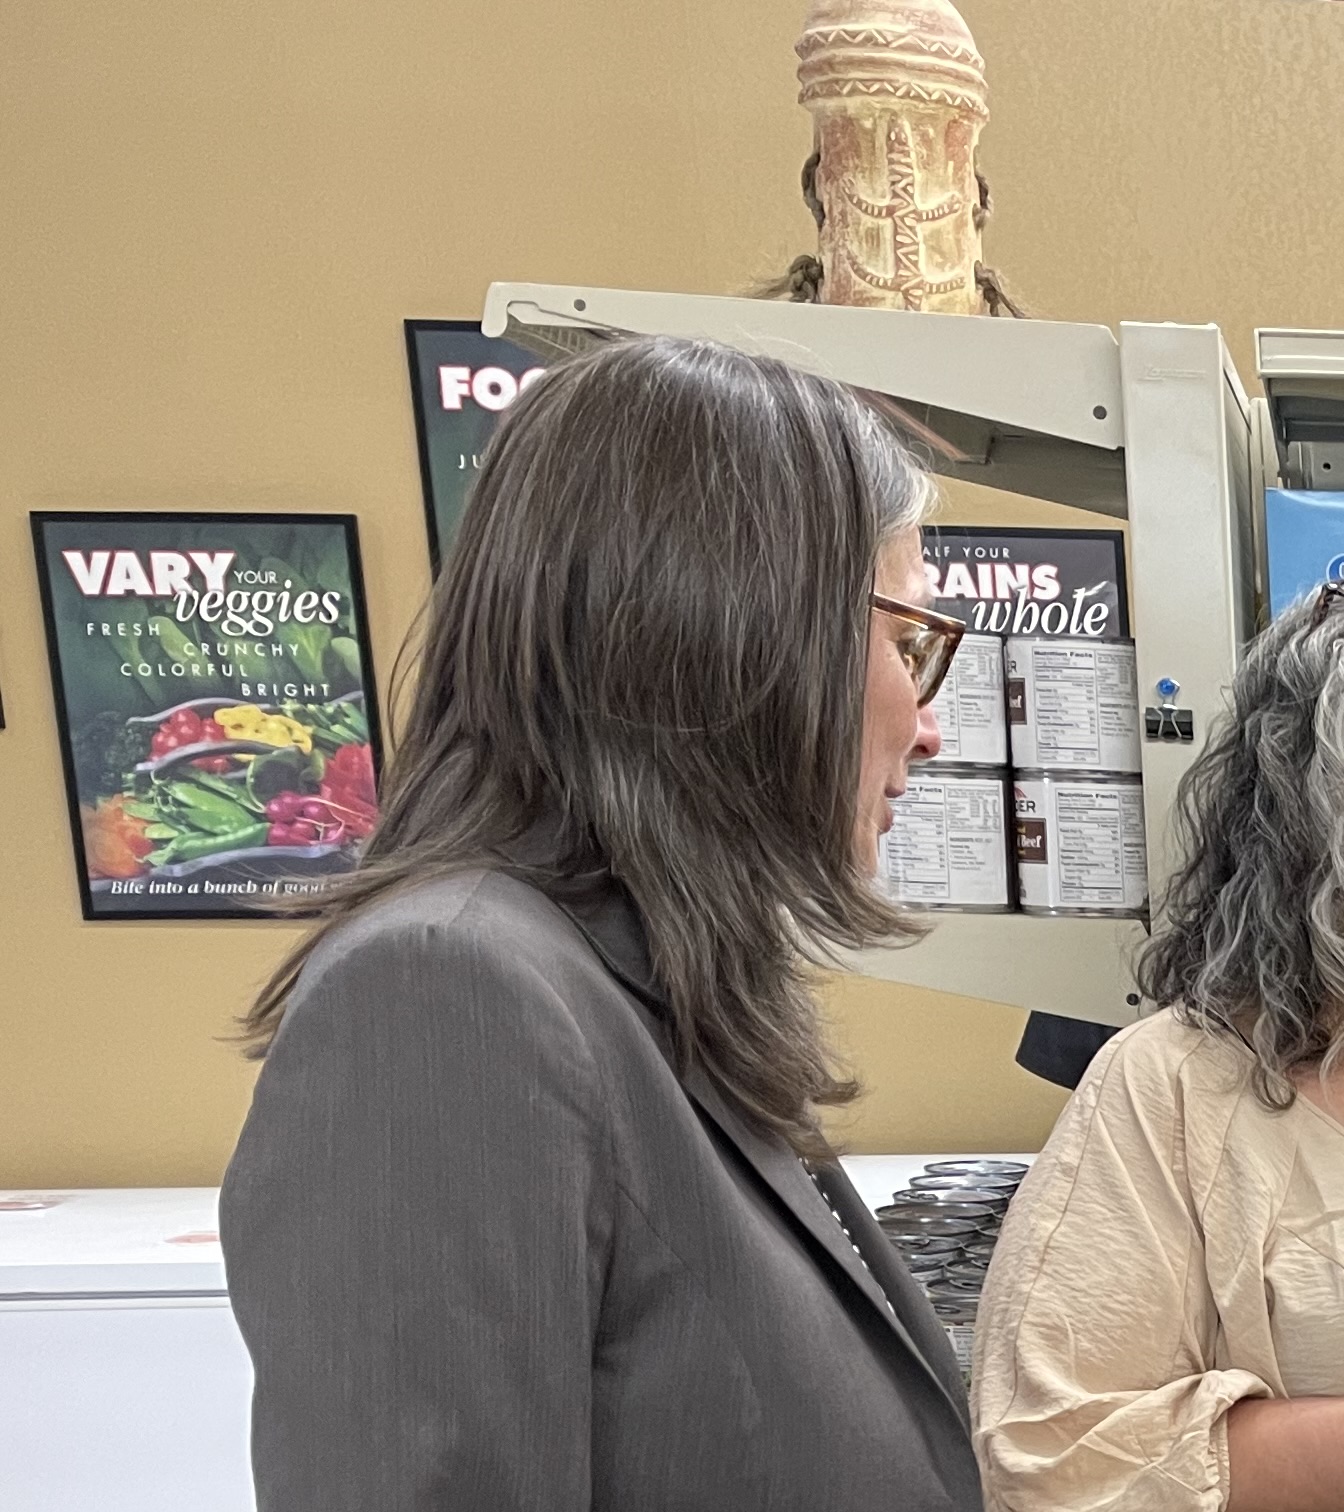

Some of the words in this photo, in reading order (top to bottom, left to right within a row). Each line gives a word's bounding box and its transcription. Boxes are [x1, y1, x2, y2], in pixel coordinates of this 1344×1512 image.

[923, 546, 951, 559] ALF
[962, 546, 1011, 559] YOUR
[61, 550, 236, 597] VARY
[234, 570, 278, 584] YOUR
[924, 562, 1061, 600] RAINS
[173, 580, 340, 636] veggies
[972, 582, 1109, 636] whole
[87, 622, 160, 636] FRESH
[183, 642, 299, 656] CRUNCHY
[120, 662, 248, 677] COLORFUL
[242, 683, 331, 696] BRIGHT
[111, 880, 143, 894] Bite
[149, 881, 183, 894] into
[187, 882, 199, 893] a
[204, 880, 257, 894] bunch
[262, 879, 279, 894] of
